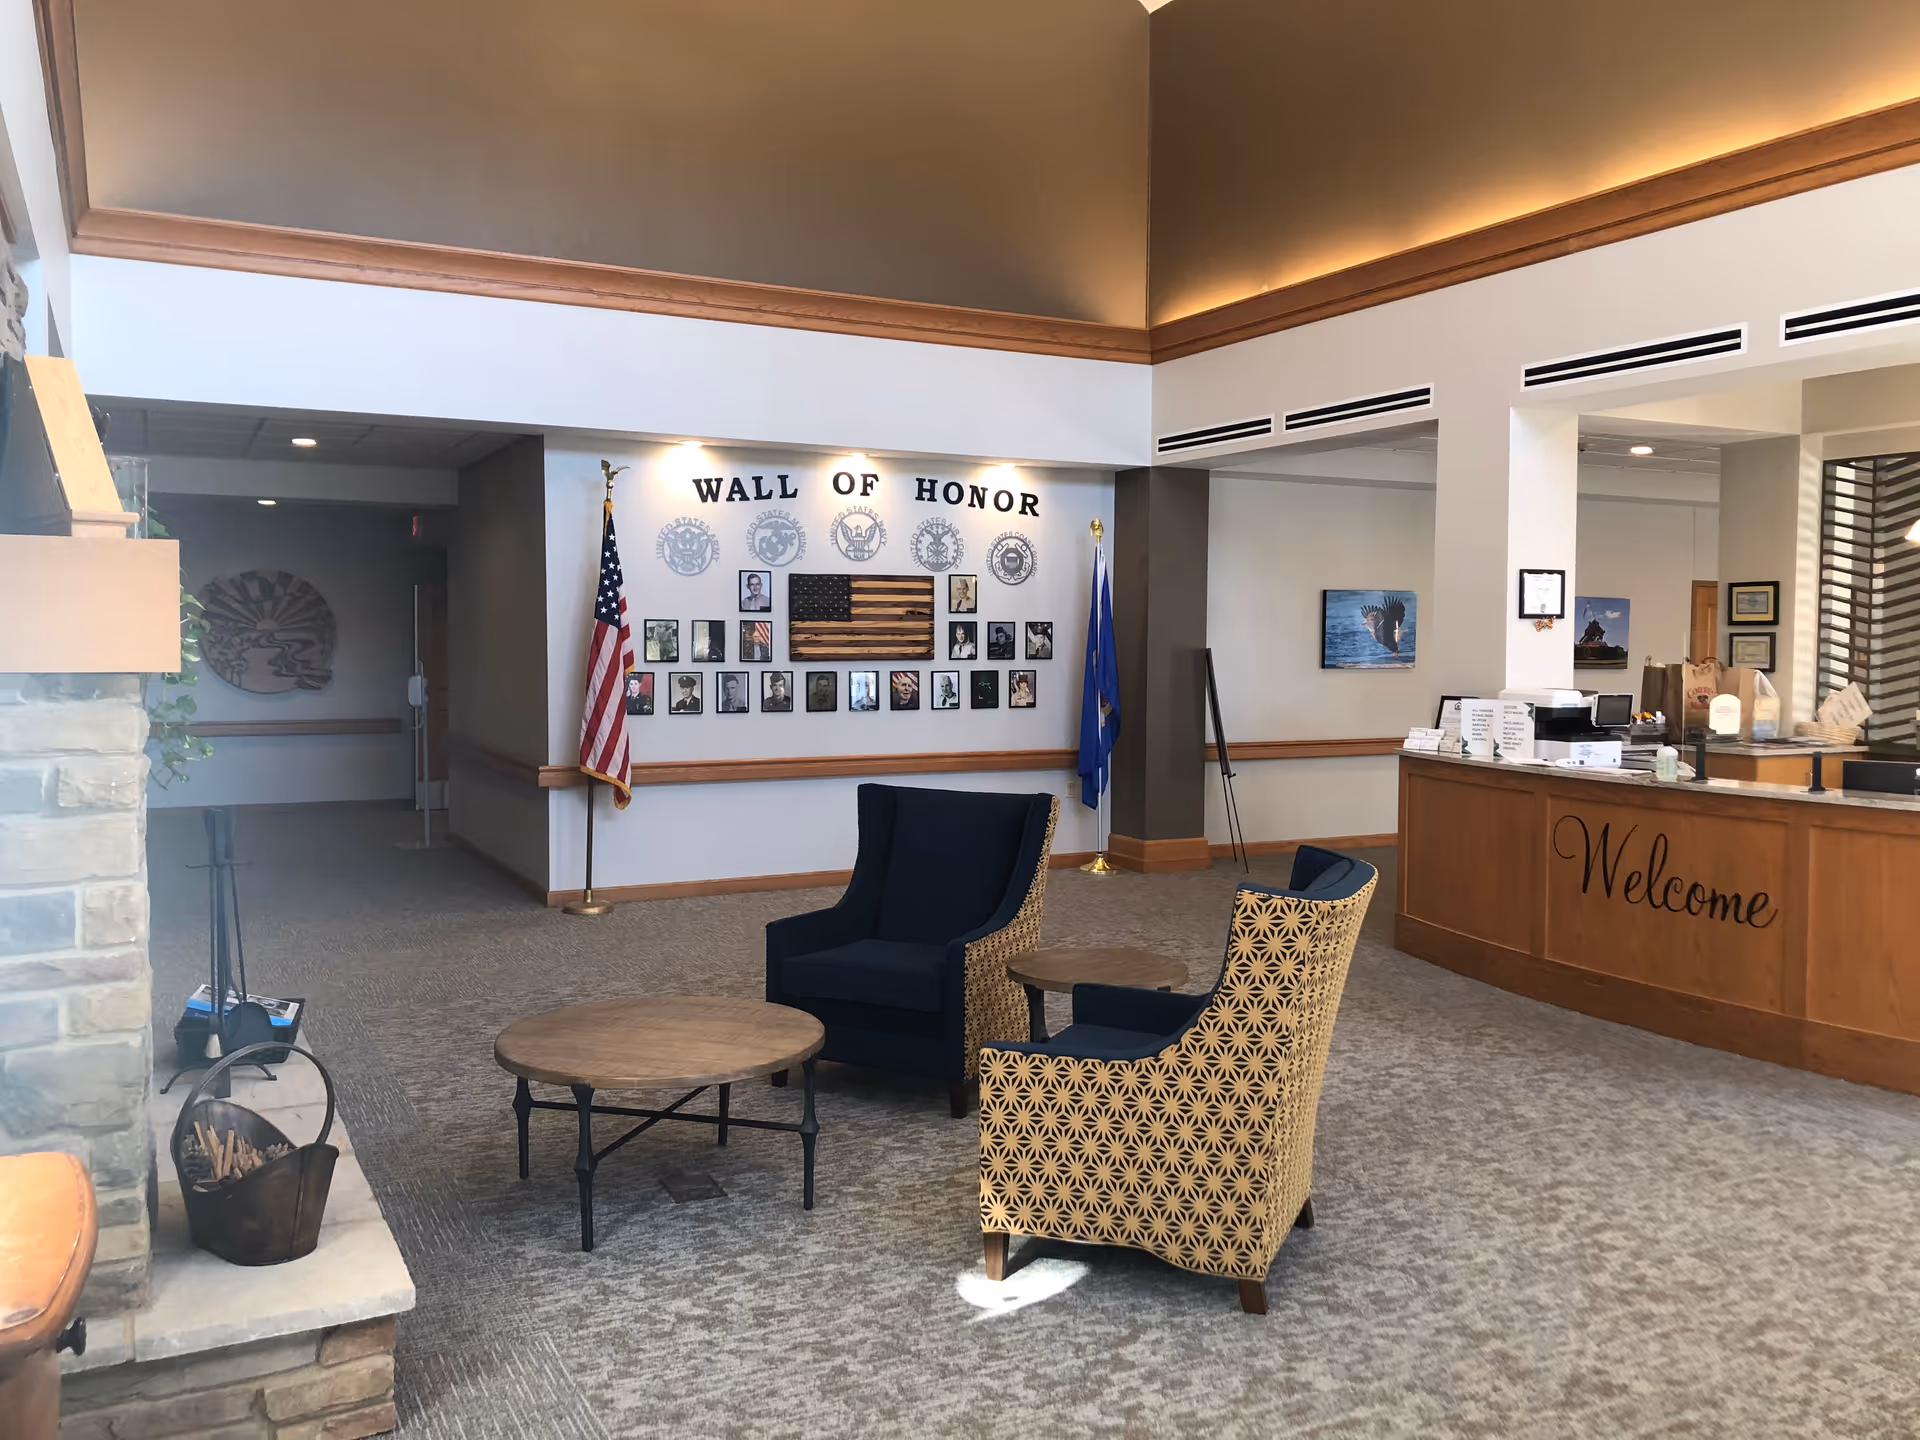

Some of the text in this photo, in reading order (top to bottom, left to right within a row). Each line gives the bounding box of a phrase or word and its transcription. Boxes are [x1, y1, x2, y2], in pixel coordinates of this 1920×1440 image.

[693, 471, 1040, 517] WALL OF HONOR
[656, 516, 721, 563] UNITED STATES ARMY
[745, 509, 807, 561] UNITED STATES MARINES
[829, 505, 889, 547] UNITED STATES NAVY
[909, 516, 965, 570] UNITED STATES AIR FORCE
[985, 531, 1041, 577] UNITED STATES COAST GUARD
[1553, 815, 1779, 929] Welcome
